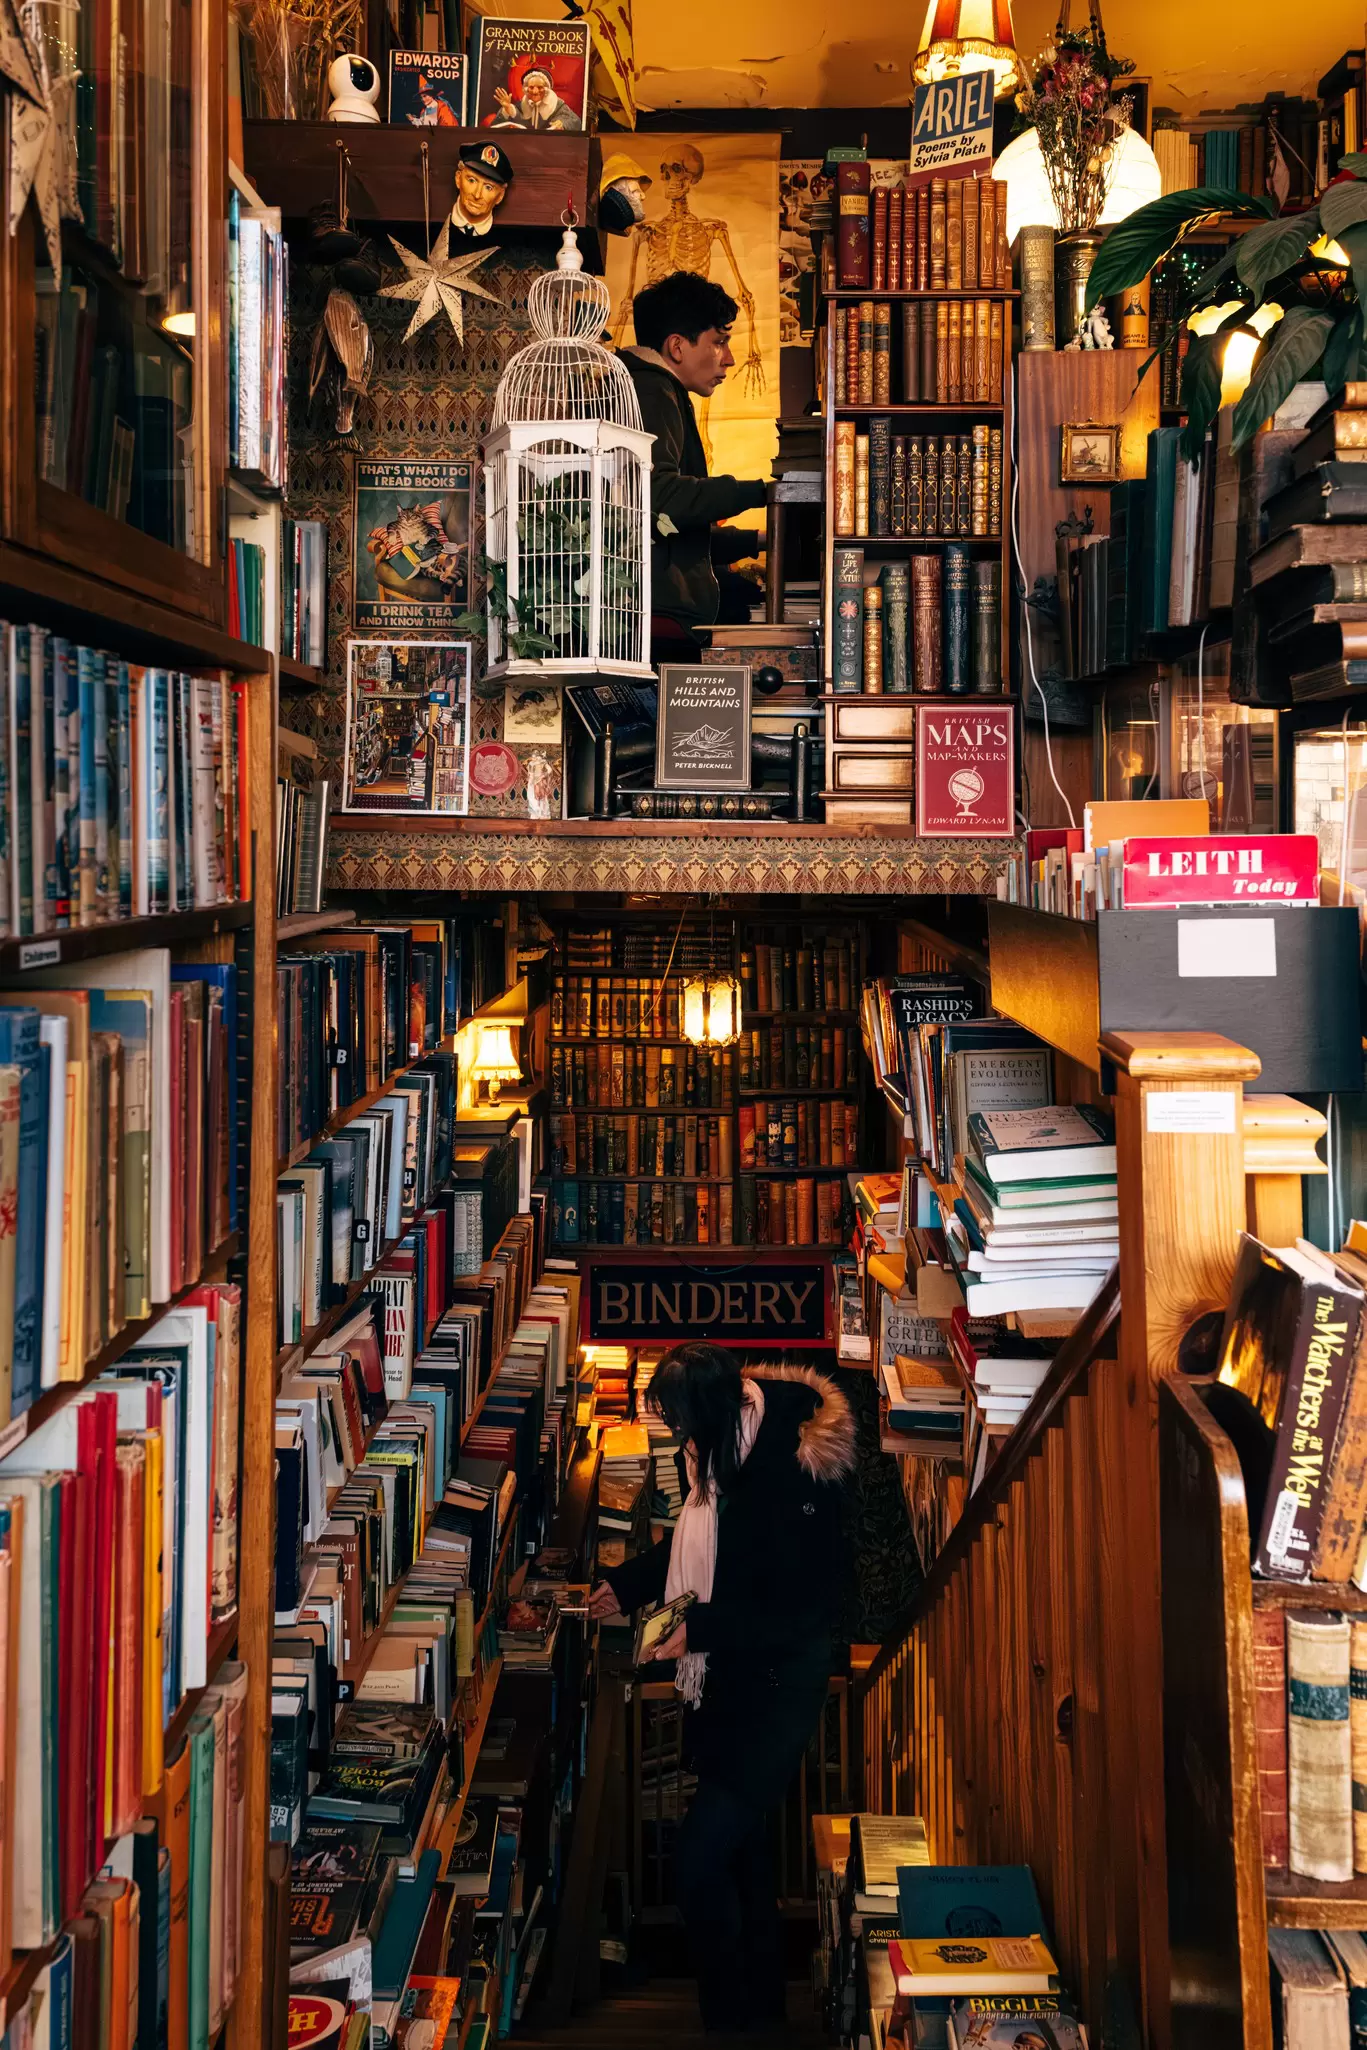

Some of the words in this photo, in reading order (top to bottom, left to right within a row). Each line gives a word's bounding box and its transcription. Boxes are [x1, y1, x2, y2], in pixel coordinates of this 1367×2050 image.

[485, 27, 545, 40] GRANNY'S
[549, 30, 584, 42] BOOK
[485, 43, 494, 53] of
[497, 39, 533, 52] FAIRY
[537, 43, 584, 54] STORIES
[395, 52, 463, 69] EDWARDS'
[426, 69, 460, 80] SOUP
[913, 71, 991, 137] ARIEL
[917, 139, 957, 156] Poems
[960, 135, 976, 147] by
[914, 151, 949, 168] Sylvia
[953, 142, 986, 159] Plath
[870, 170, 893, 181] REE
[360, 465, 400, 475] THAT'S
[404, 466, 440, 476] WHAT
[442, 466, 446, 476] I
[450, 467, 468, 476] DO
[374, 477, 379, 486] I
[381, 477, 412, 487] READ
[415, 477, 456, 488] BOOKS
[842, 560, 857, 568] LIFE
[373, 605, 377, 616] I
[381, 605, 424, 617] DRINK
[428, 606, 453, 617] TEA
[360, 616, 382, 625] AND
[390, 617, 424, 626] KNOW
[427, 618, 456, 627] THIN
[674, 687, 706, 696] HILLS
[709, 687, 736, 697] AND
[670, 698, 740, 709] MOUNTAINS
[927, 724, 1007, 746] MAPS
[927, 752, 1006, 761] MAP-MAKERS
[970, 817, 1005, 825] LYNAM
[1146, 849, 1265, 877] LEITH
[1233, 878, 1299, 896] Today
[902, 999, 973, 1011] RASHID'S
[906, 1012, 970, 1023] LEGACY
[336, 1049, 347, 1064] B
[970, 1060, 1042, 1068] EMERGENT
[970, 1069, 1042, 1079] EVOLUTION
[404, 1171, 412, 1185] H
[356, 1224, 367, 1239] G
[598, 1281, 817, 1324] BINDERY
[1315, 1296, 1335, 1324] The
[887, 1316, 941, 1329] GERMAIN
[1296, 1321, 1349, 1430] Watchers
[1292, 1430, 1308, 1452] the
[1284, 1454, 1324, 1509] Well
[346, 1543, 356, 1552] III
[338, 1684, 349, 1699] P
[969, 1997, 1059, 2013] BIGGLES
